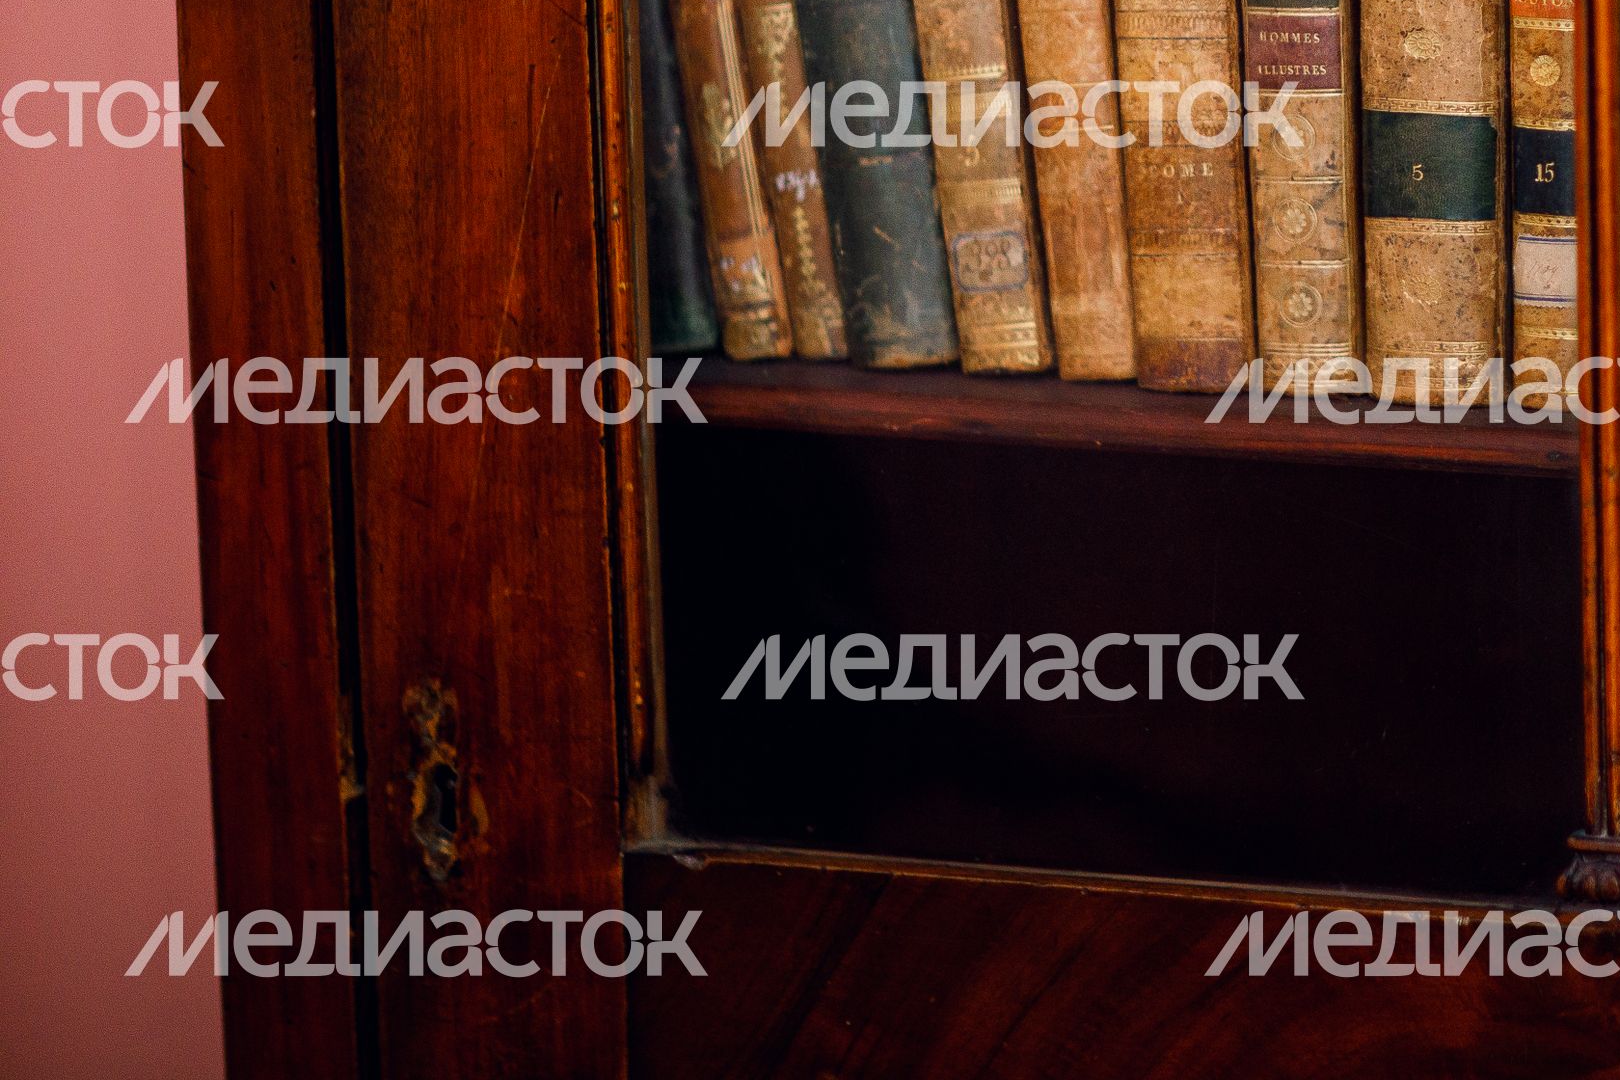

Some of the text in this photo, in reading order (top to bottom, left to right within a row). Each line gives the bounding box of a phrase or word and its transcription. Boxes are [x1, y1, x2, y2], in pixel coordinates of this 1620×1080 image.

[1259, 32, 1321, 44] HOMMES
[1258, 64, 1327, 76] ILLUSTRES
[1411, 163, 1425, 181] 5
[1534, 161, 1556, 183] 15
